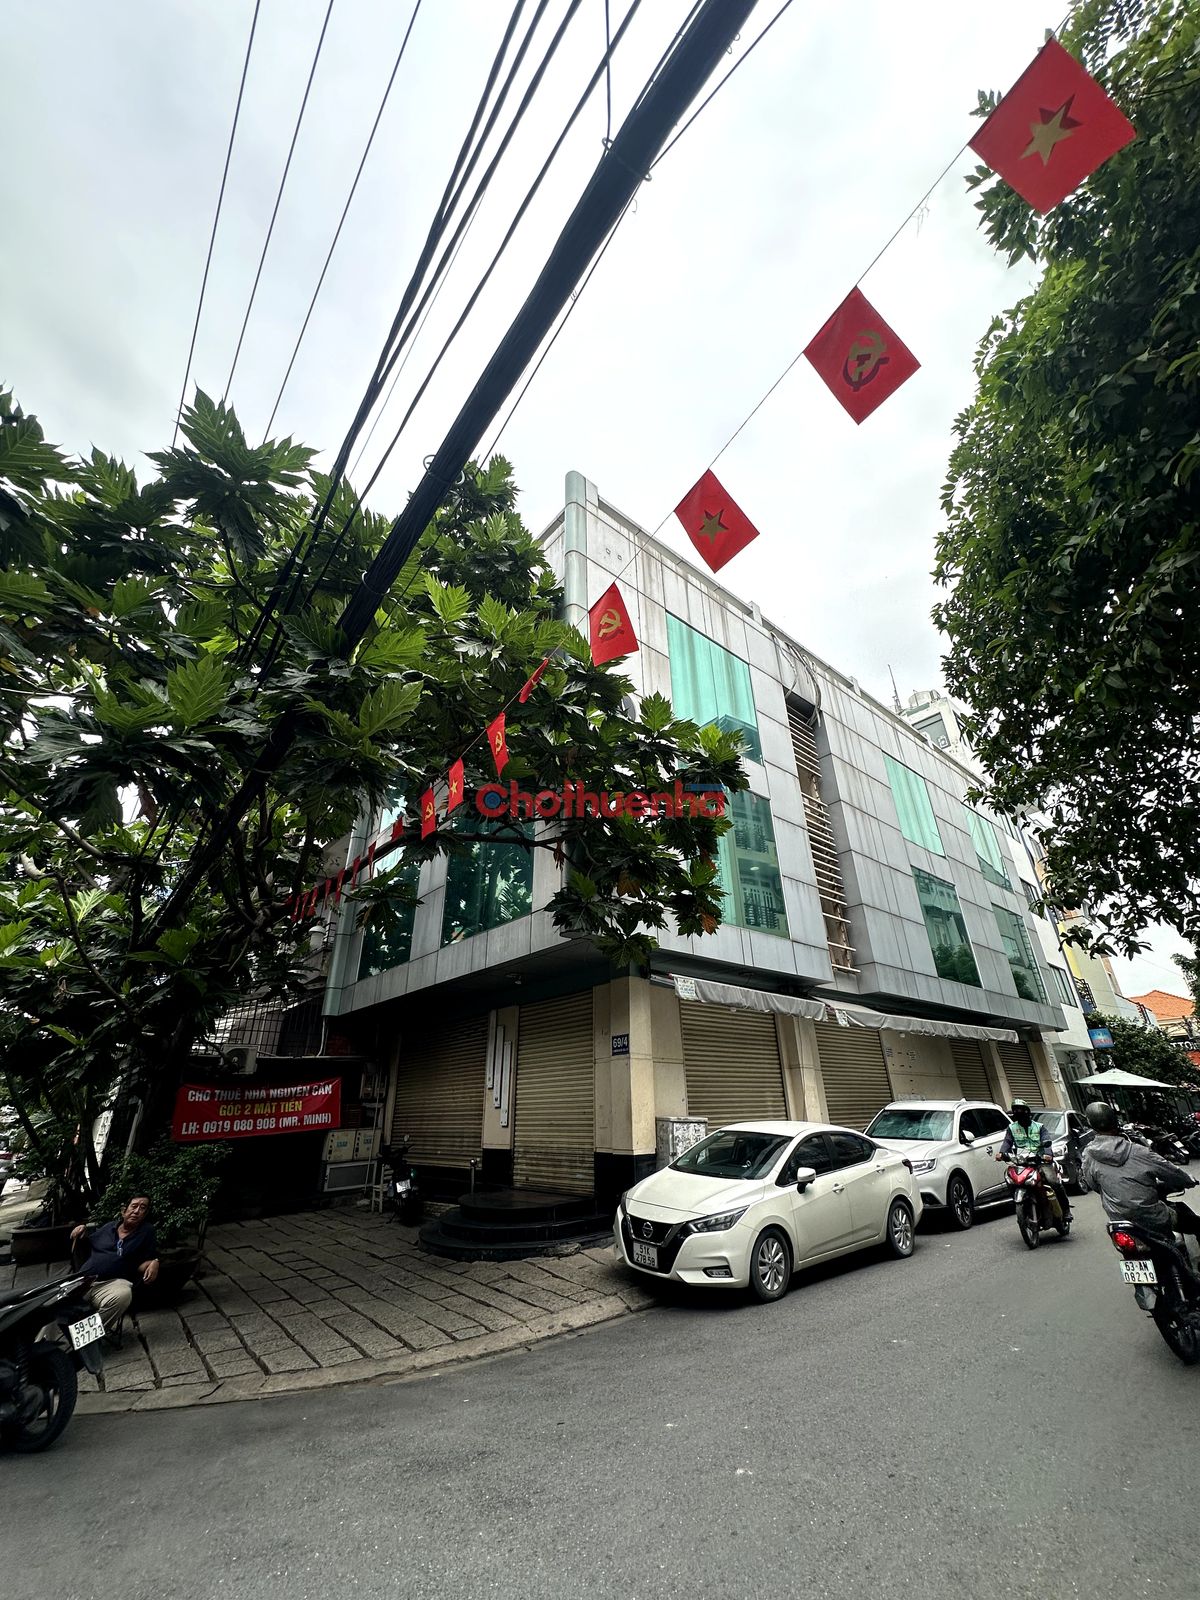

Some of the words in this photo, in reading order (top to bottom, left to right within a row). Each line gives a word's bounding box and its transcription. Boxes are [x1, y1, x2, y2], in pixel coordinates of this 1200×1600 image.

[188, 1090, 211, 1102] CHO
[214, 1088, 241, 1101] THUÊ
[269, 1085, 310, 1099] NGUYÊN
[311, 1082, 332, 1096] CĂN
[219, 1102, 242, 1116] GÓC
[244, 1103, 252, 1115] 2
[181, 1122, 200, 1135] LH:
[202, 1120, 231, 1133] 0919
[233, 1119, 254, 1132] 080
[256, 1117, 276, 1130] 908
[279, 1115, 301, 1129] (MR.
[303, 1112, 332, 1126] MINH)
